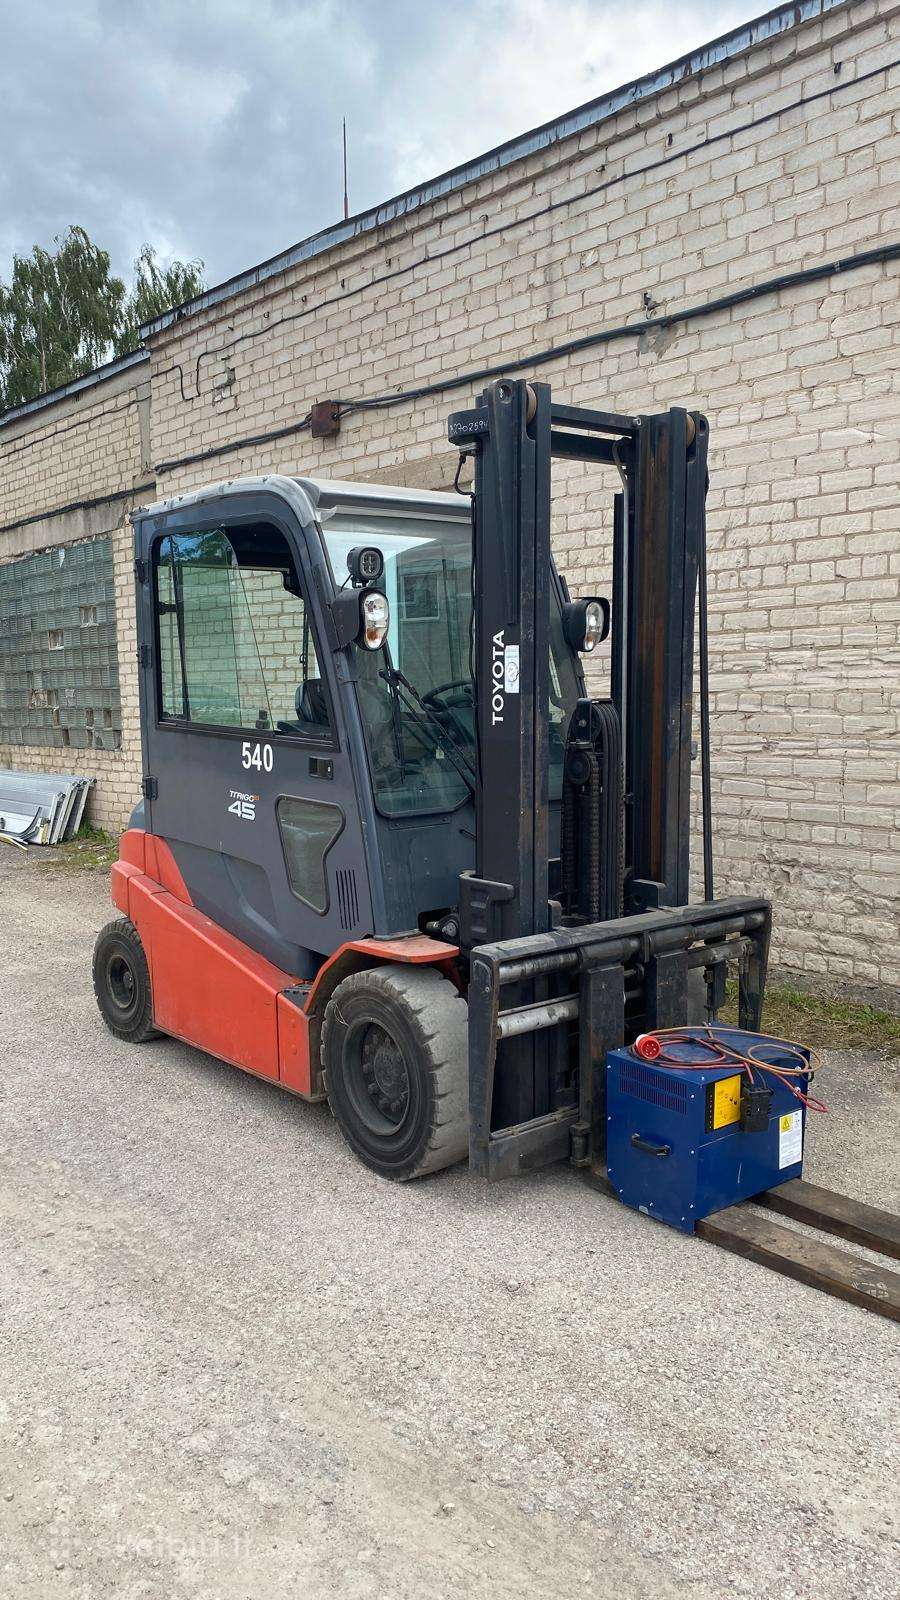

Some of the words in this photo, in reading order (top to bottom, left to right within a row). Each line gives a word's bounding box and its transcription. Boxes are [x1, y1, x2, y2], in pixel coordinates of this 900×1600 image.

[492, 630, 505, 726] TOYOTA
[242, 742, 273, 772] 540
[228, 800, 256, 820] 45
